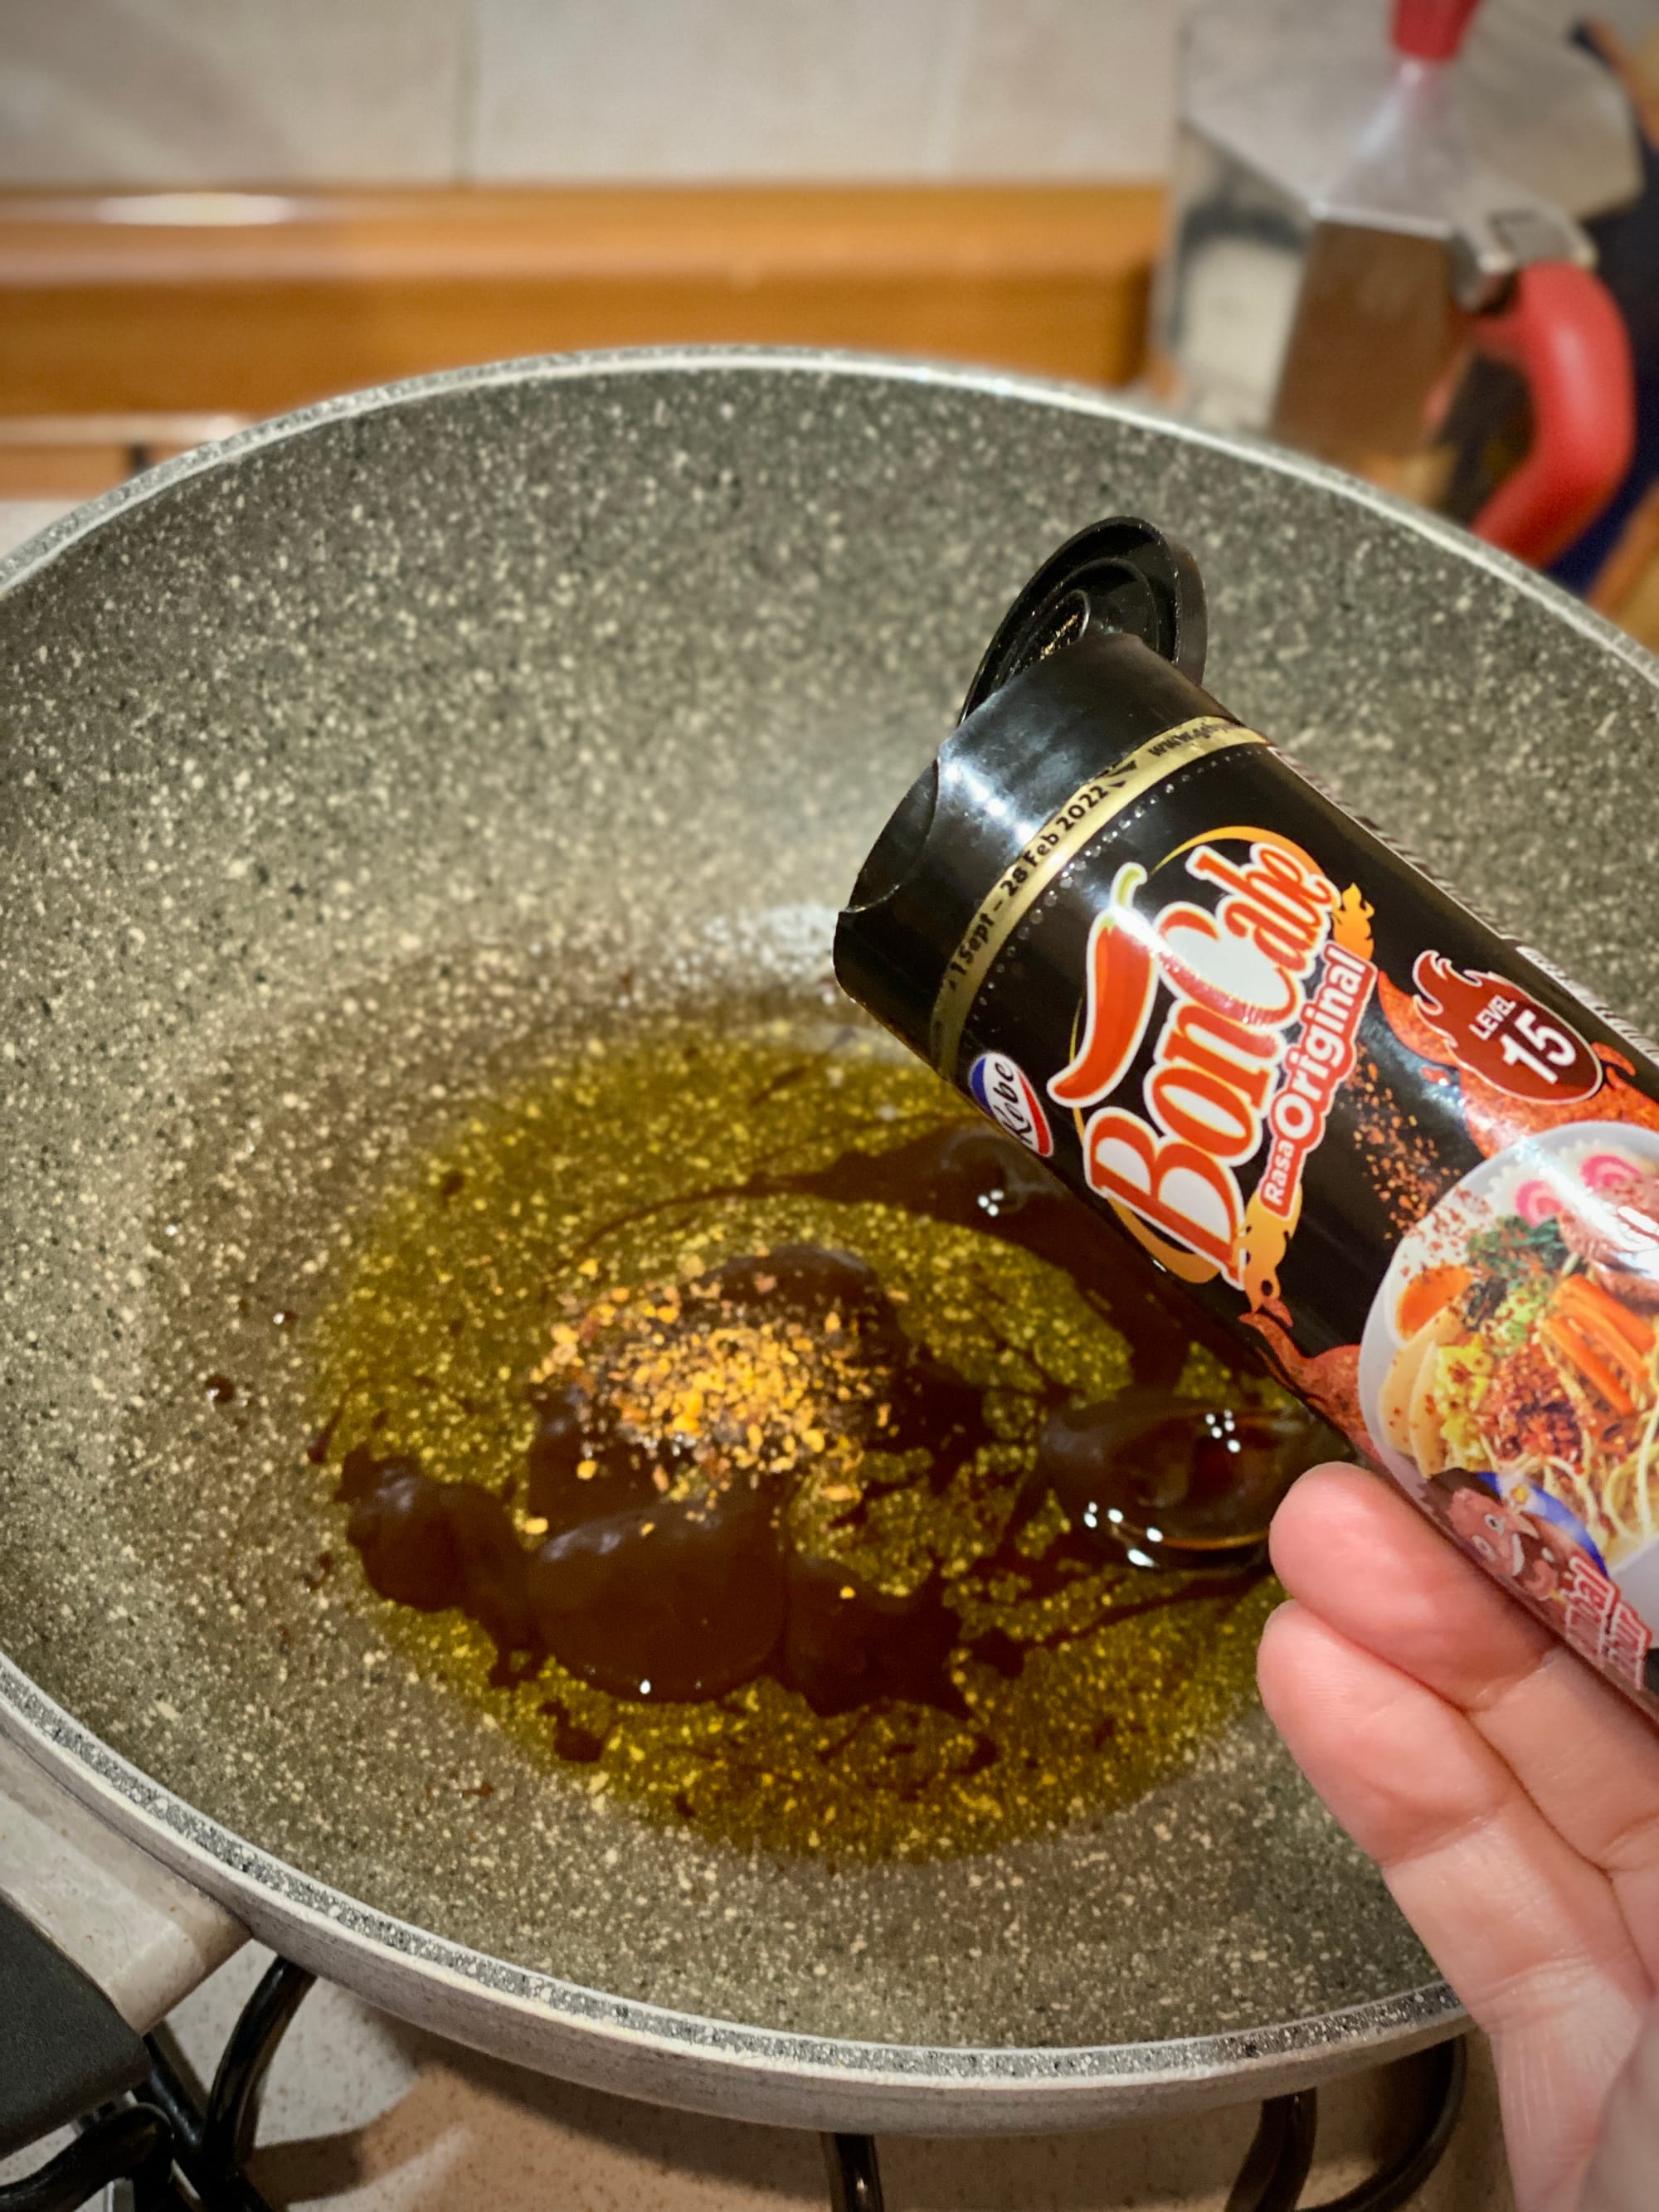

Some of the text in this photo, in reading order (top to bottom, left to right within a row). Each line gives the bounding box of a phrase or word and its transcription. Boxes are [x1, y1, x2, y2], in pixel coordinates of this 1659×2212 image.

[959, 912, 995, 965] Sept
[1000, 867, 1029, 897] 28
[1022, 833, 1059, 867] Feb
[1056, 785, 1109, 832] 2022
[1468, 994, 1517, 1041] LEVEL
[1500, 1009, 1576, 1085] 15
[992, 1062, 1034, 1145] Kobe
[1263, 946, 1366, 1205] Rasa Original
